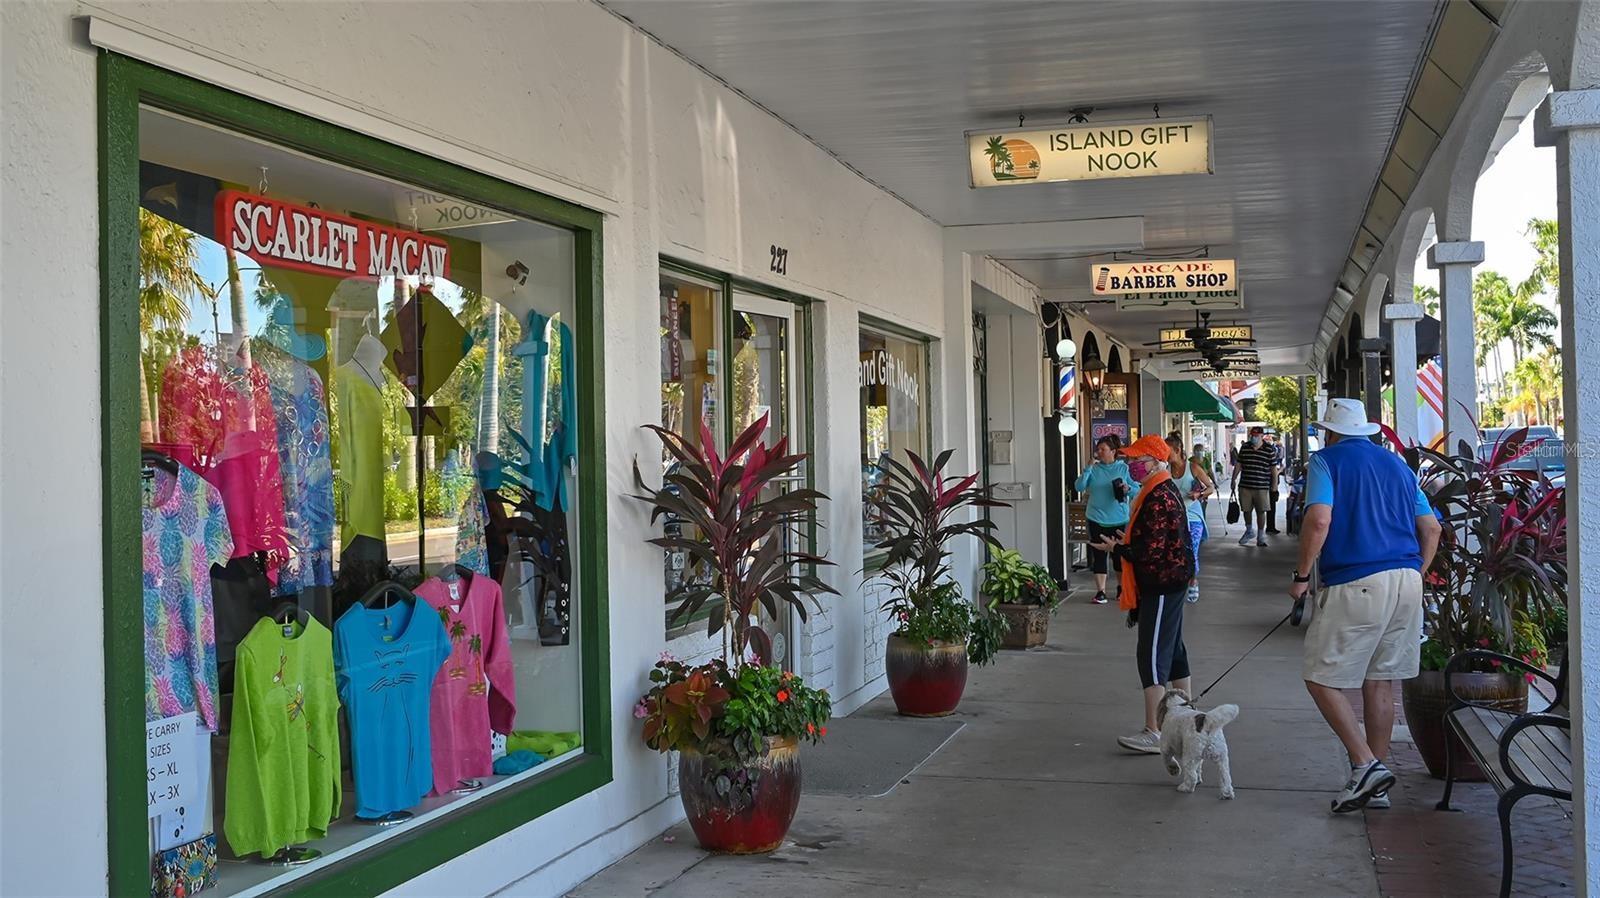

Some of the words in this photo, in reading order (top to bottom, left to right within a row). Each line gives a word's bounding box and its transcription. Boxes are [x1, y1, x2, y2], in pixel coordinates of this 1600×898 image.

[1050, 130, 1133, 151] ISLAND
[1140, 125, 1193, 145] GIFT
[1088, 151, 1158, 172] NOOK
[232, 199, 358, 272] SCARLET
[367, 230, 447, 278] MACAW
[769, 244, 788, 275] 227
[1127, 263, 1214, 274] ARCADE
[1110, 275, 1177, 290] BARBER
[1185, 273, 1228, 288] SHOP
[1212, 328, 1247, 338] ney's
[859, 350, 876, 386] and
[878, 350, 895, 388] Gift
[896, 357, 920, 406] Nook
[1095, 426, 1126, 437] OPEN
[155, 722, 180, 738] CARRY
[151, 743, 170, 758] SIZES
[167, 762, 178, 776] XL
[167, 783, 180, 800] 3X
